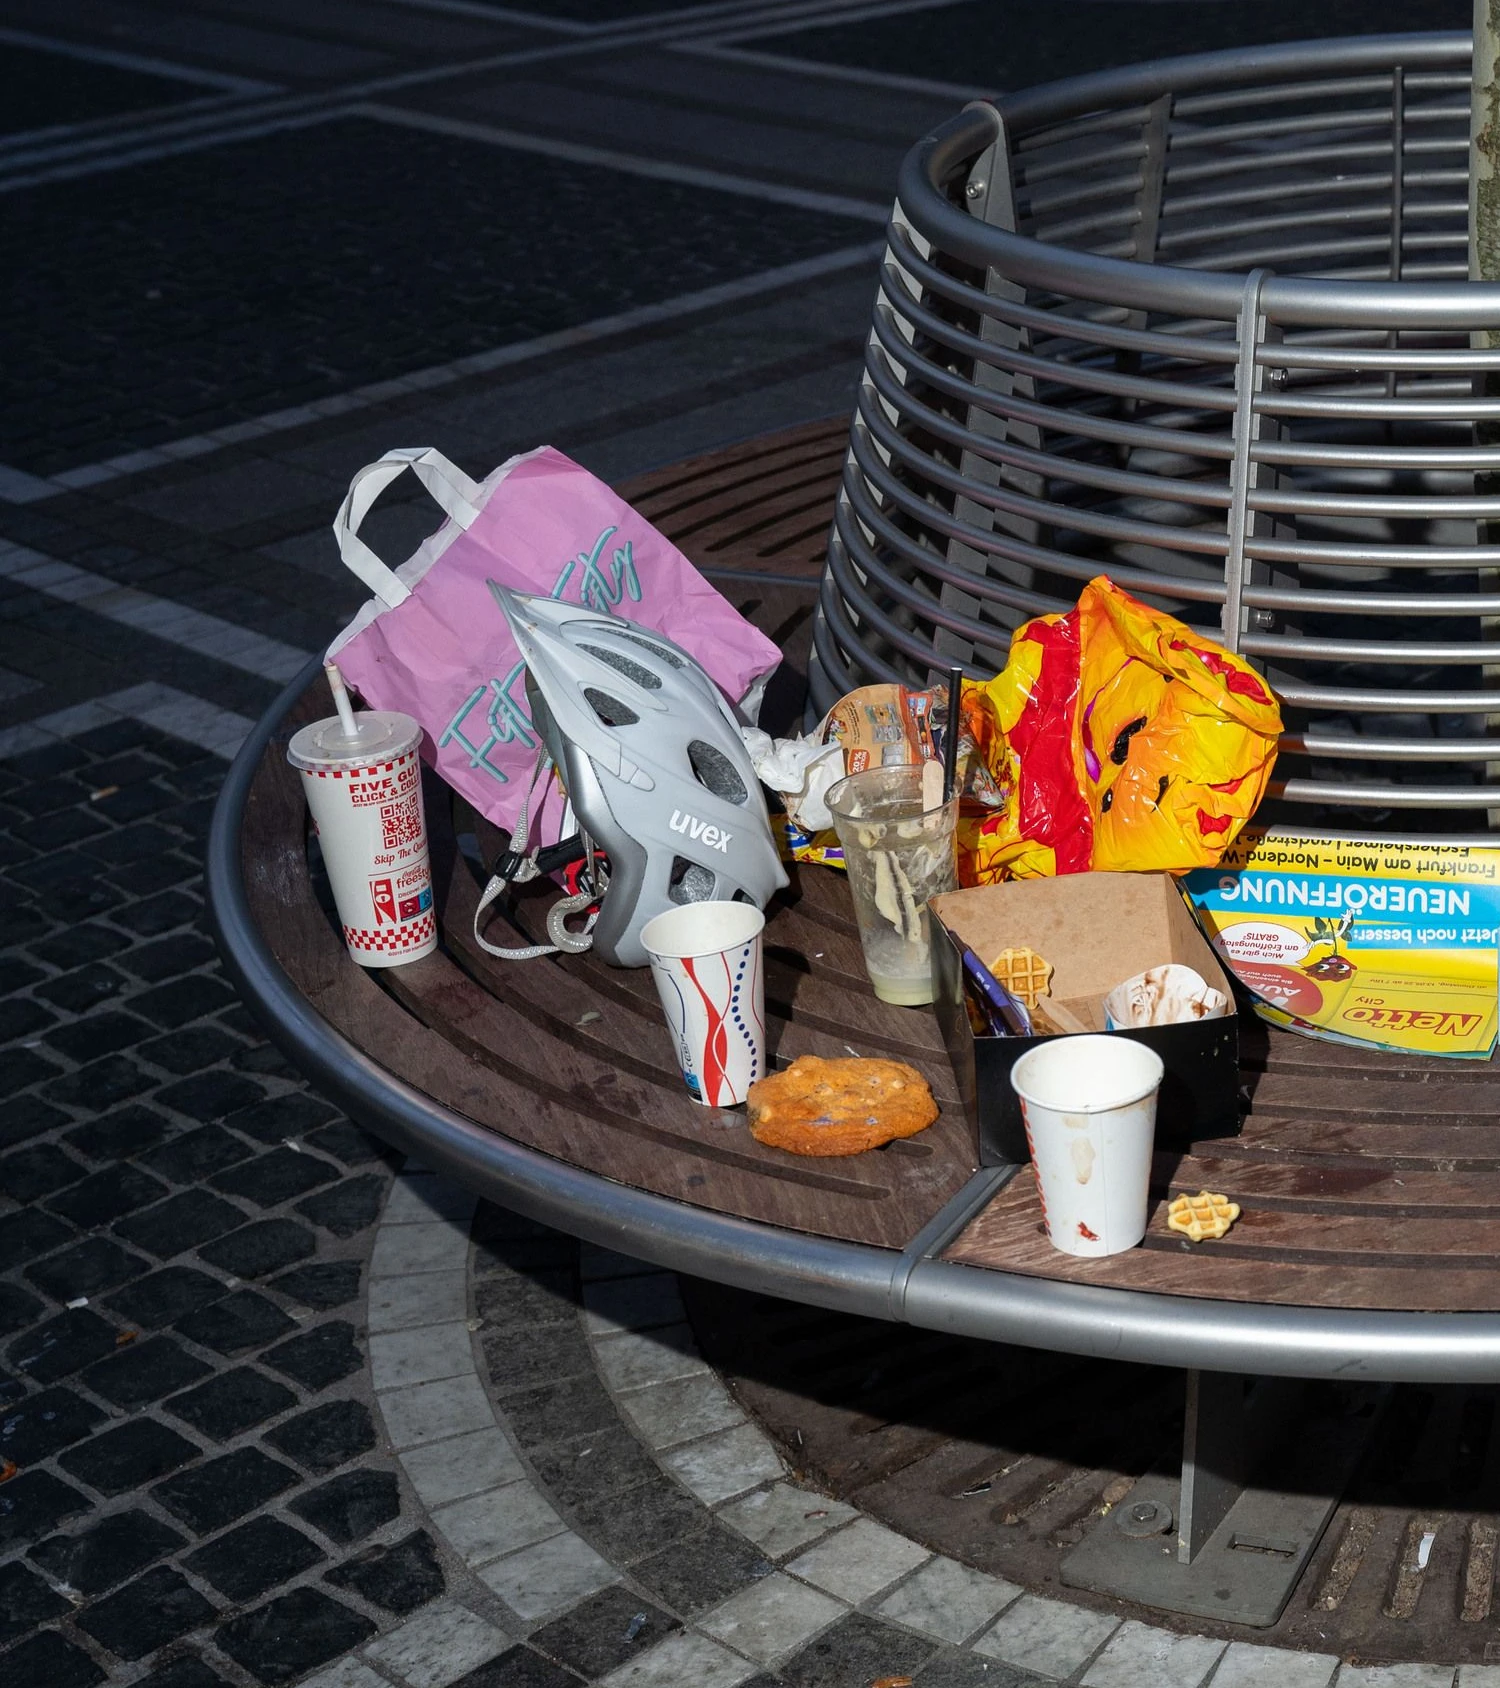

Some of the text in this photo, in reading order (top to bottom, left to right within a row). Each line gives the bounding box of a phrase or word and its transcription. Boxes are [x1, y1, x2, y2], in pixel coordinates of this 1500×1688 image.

[349, 777, 393, 793] FIVE
[351, 790, 387, 804] CLICK
[390, 787, 398, 796] &
[669, 809, 734, 853] uvex
[374, 854, 395, 867] Skip
[397, 848, 411, 859] The
[1336, 855, 1379, 874] Main
[1384, 858, 1411, 871] am
[1415, 858, 1496, 879] Frankfurt
[1218, 876, 1470, 916] NEUERÖFFNUNG
[1353, 927, 1498, 944] Jetzt noch besser:
[1219, 938, 1283, 952] Eröffnungstag
[1242, 948, 1261, 958] gibt
[1262, 951, 1284, 960] Mich
[1355, 996, 1385, 1006] City
[1342, 1007, 1483, 1038] Netto
